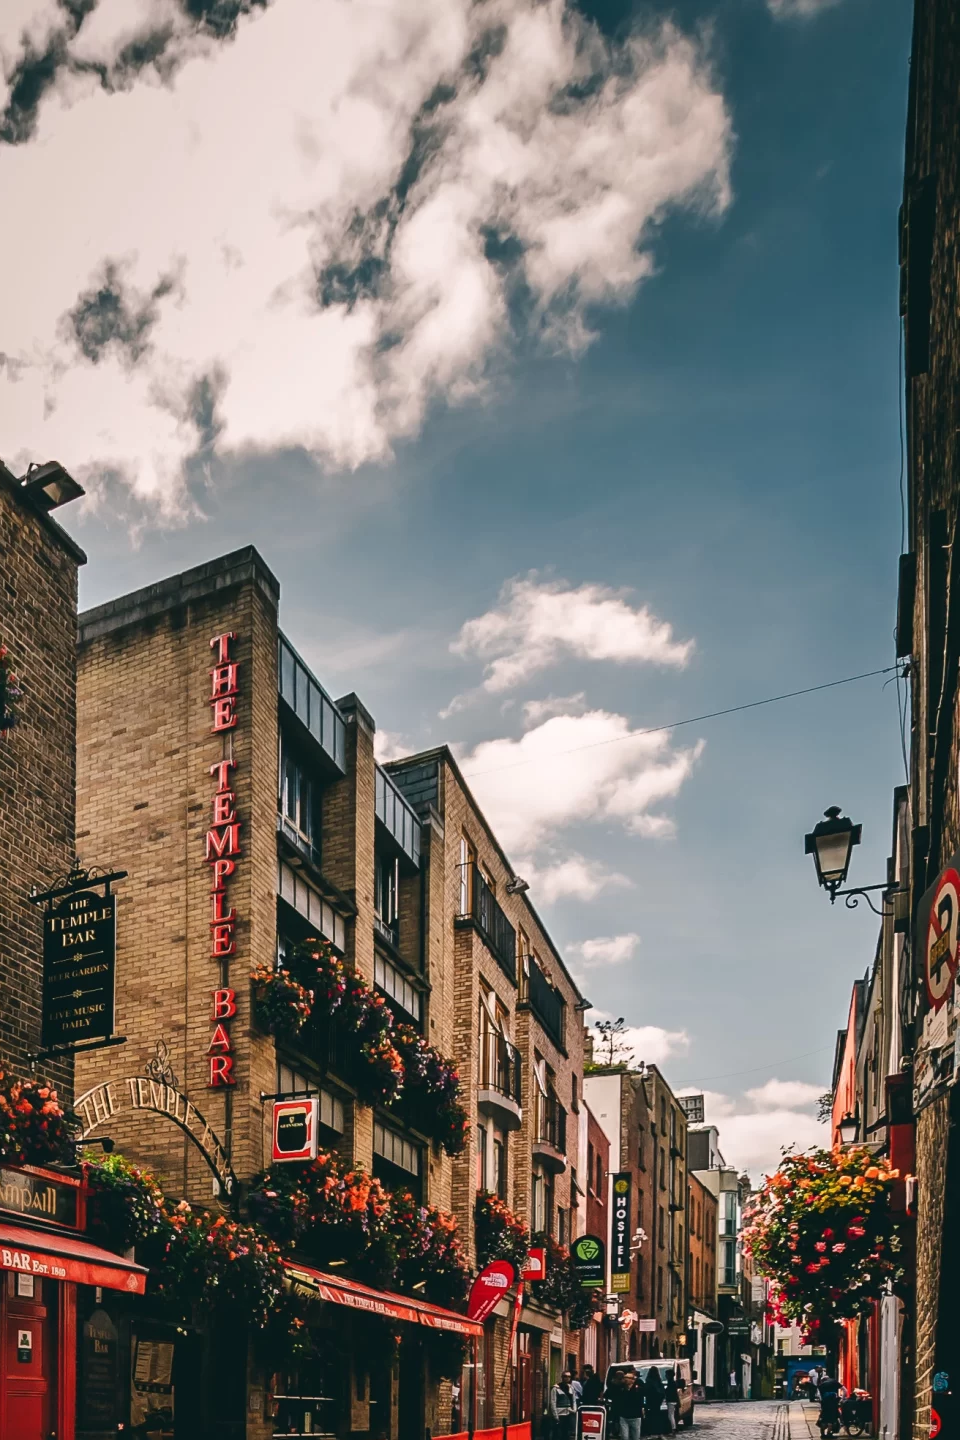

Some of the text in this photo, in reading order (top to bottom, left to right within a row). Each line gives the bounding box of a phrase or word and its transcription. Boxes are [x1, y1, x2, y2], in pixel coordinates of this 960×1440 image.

[210, 632, 239, 733] THE
[206, 759, 241, 958] TEMPLE
[68, 898, 90, 912] THE
[47, 907, 112, 932] TEMPLE
[62, 929, 96, 947] BAR
[72, 963, 109, 978] GARDEN
[73, 1003, 106, 1017] MUSIC
[62, 1017, 92, 1031] DAILY
[208, 986, 238, 1088] BAR
[79, 1083, 121, 1130] THE
[616, 1197, 627, 1267] HOSTEL
[2, 1249, 32, 1271] BAR
